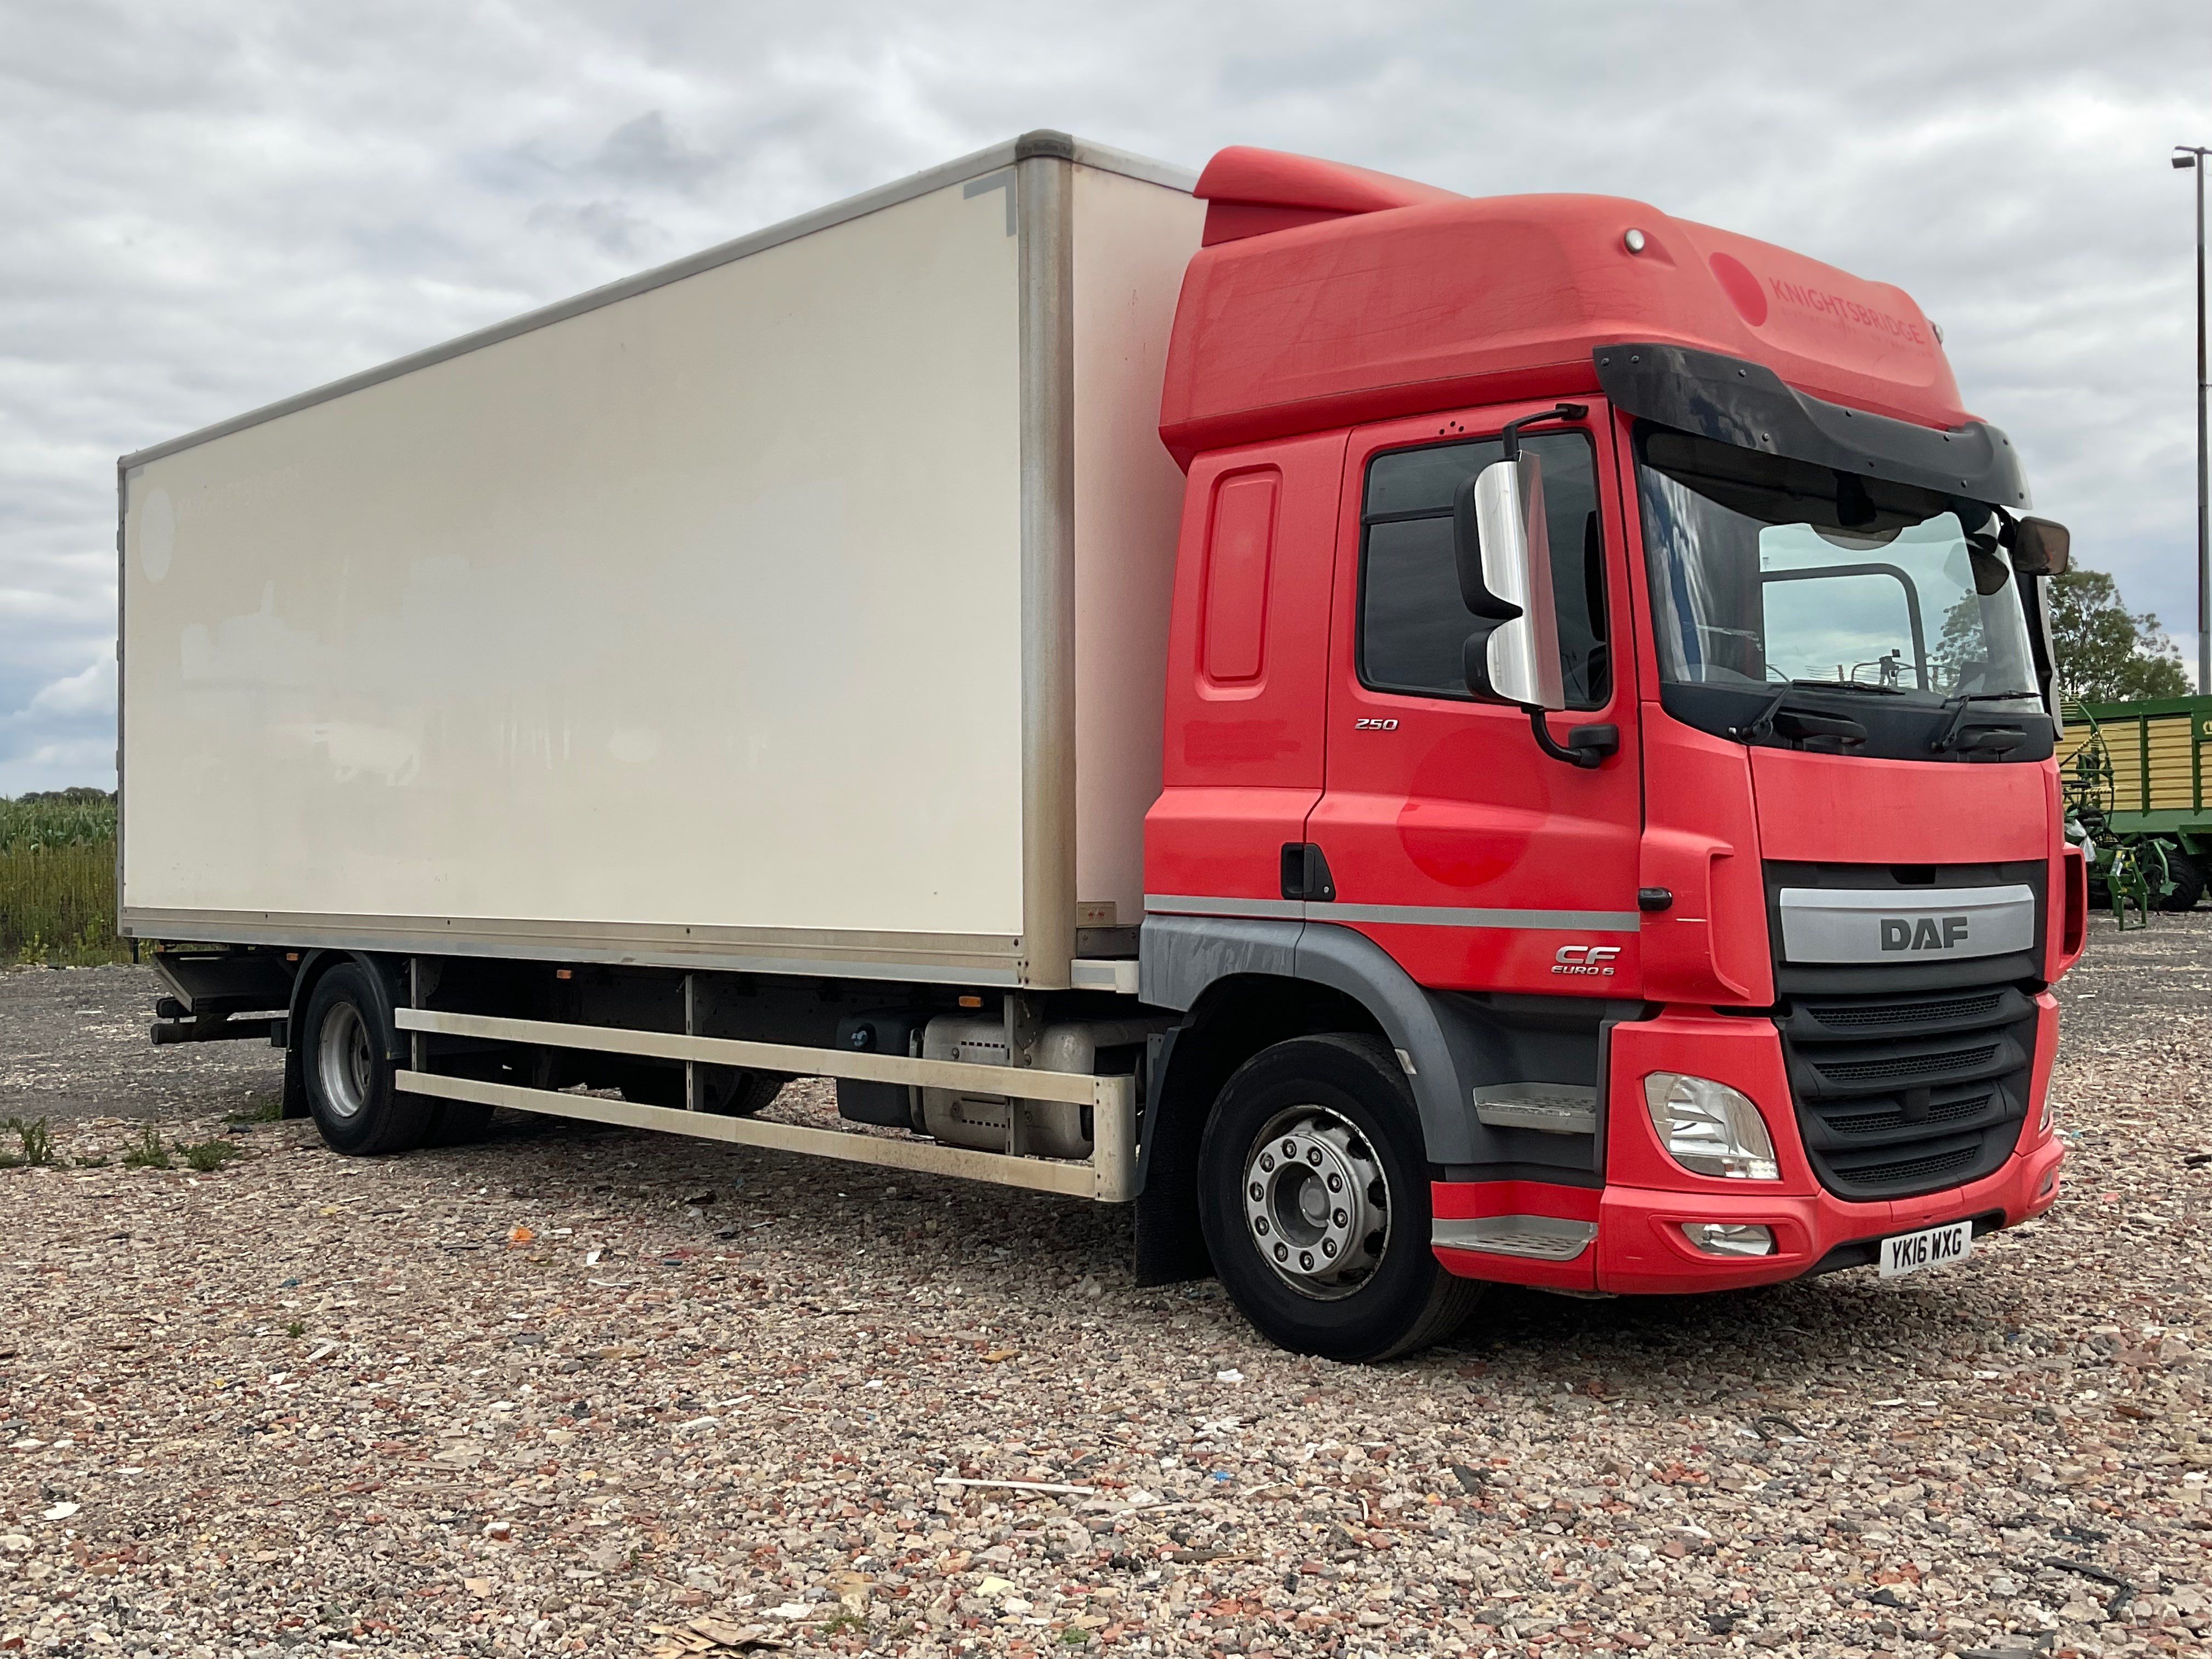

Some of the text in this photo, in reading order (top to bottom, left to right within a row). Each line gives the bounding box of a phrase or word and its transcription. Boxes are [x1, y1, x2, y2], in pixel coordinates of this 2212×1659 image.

[1768, 276, 1926, 345] KNIGHTSBRIDGE
[1355, 718, 1398, 730] 250
[1880, 917, 1968, 951] DAF
[1555, 945, 1621, 964] CF
[1551, 966, 1615, 975] EURO 6
[1892, 1228, 1962, 1269] YK16 WXG
